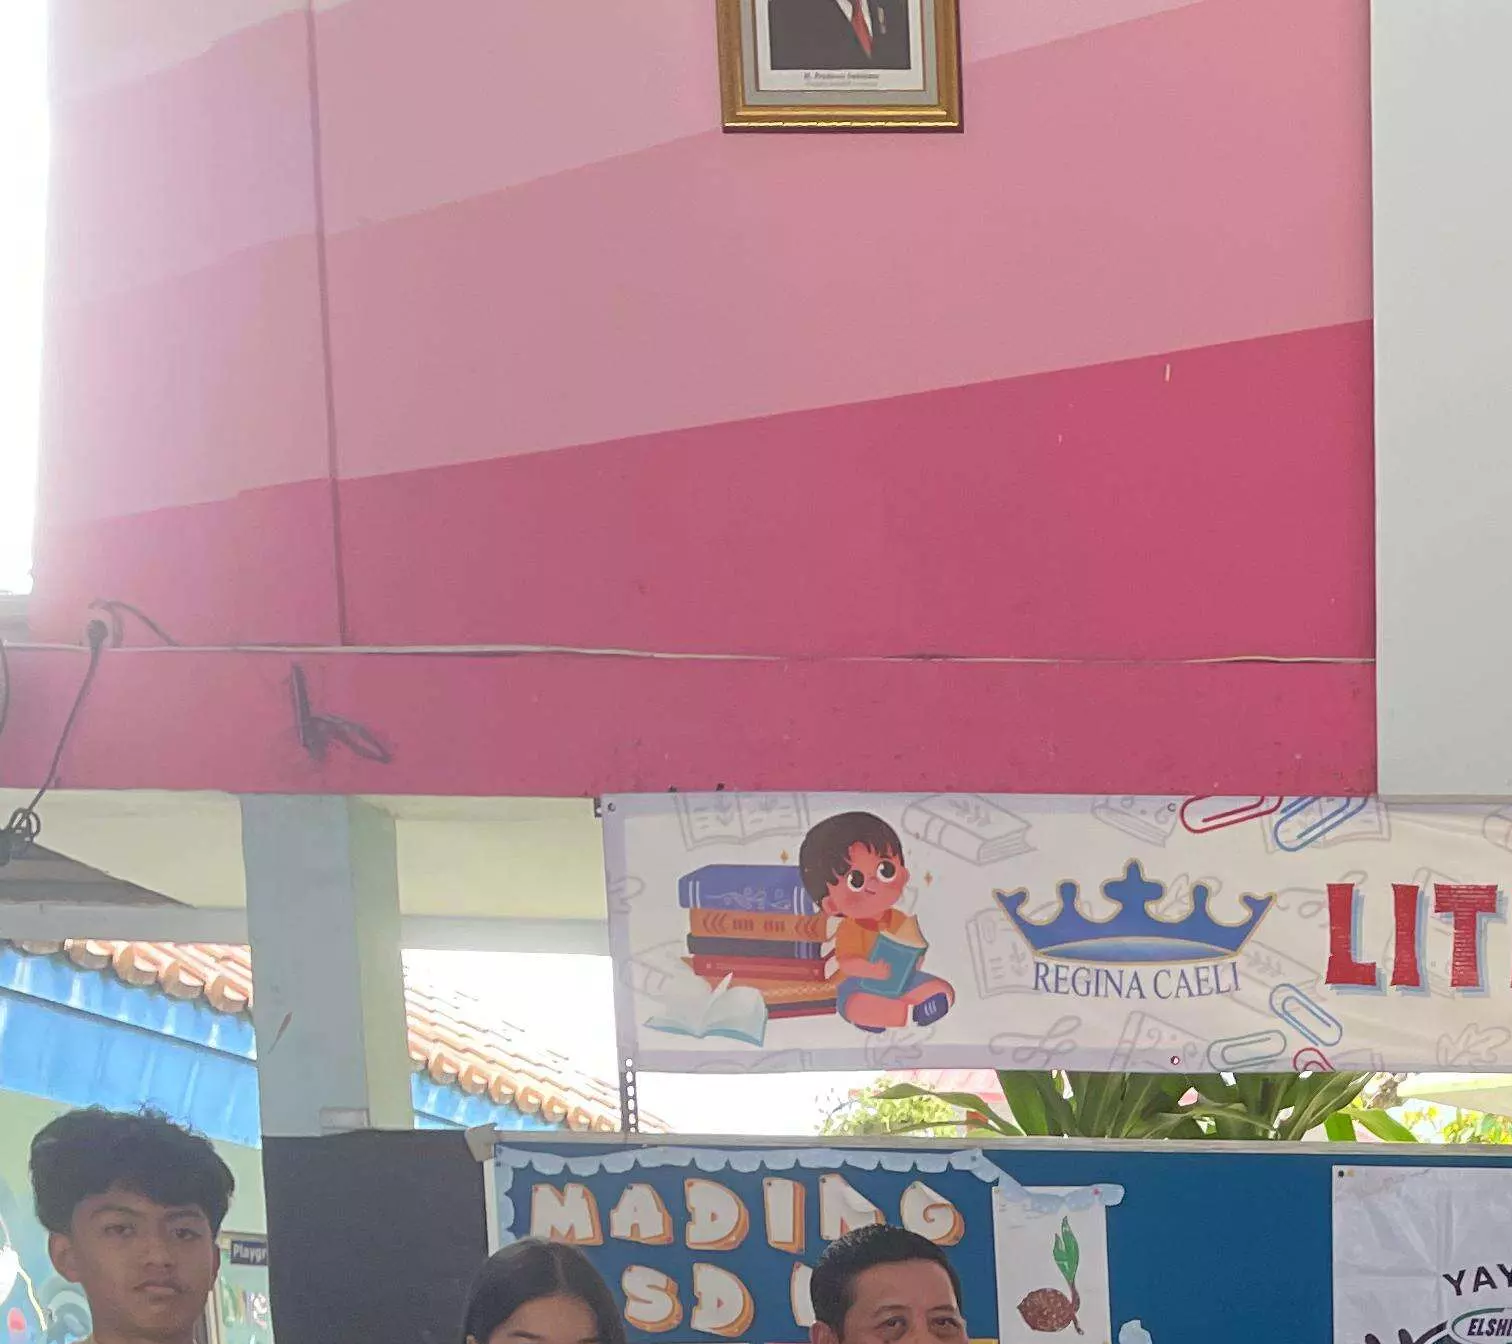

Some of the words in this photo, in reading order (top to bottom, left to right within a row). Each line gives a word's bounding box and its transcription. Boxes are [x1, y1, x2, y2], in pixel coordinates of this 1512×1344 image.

[1031, 961, 1150, 1001] REGINA
[1154, 961, 1242, 1000] CAELI
[621, 1262, 754, 1338] SD
